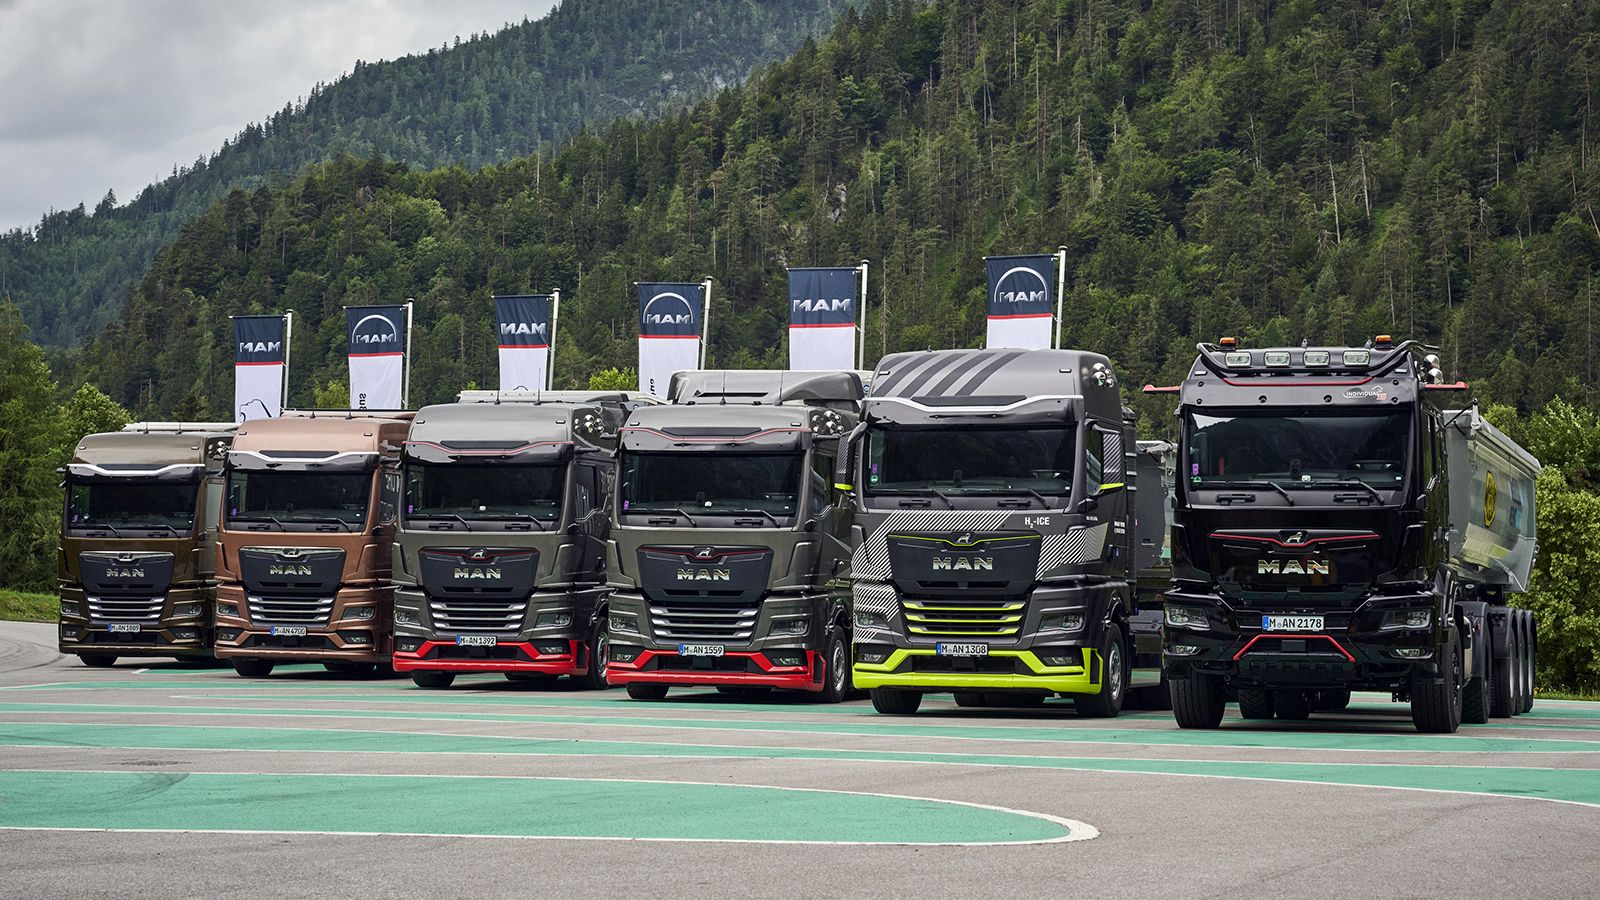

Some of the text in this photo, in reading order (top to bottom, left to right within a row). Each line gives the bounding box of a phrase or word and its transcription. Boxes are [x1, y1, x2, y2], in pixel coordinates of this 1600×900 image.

[932, 557, 993, 570] MAN
[1258, 559, 1329, 574] MAN
[106, 568, 145, 578] MAN
[269, 565, 312, 575] MAN
[454, 568, 501, 579] MAN
[677, 568, 731, 581] MAN
[1297, 618, 1322, 628] 2178
[704, 645, 723, 654] 1559
[965, 645, 986, 654] 1308
